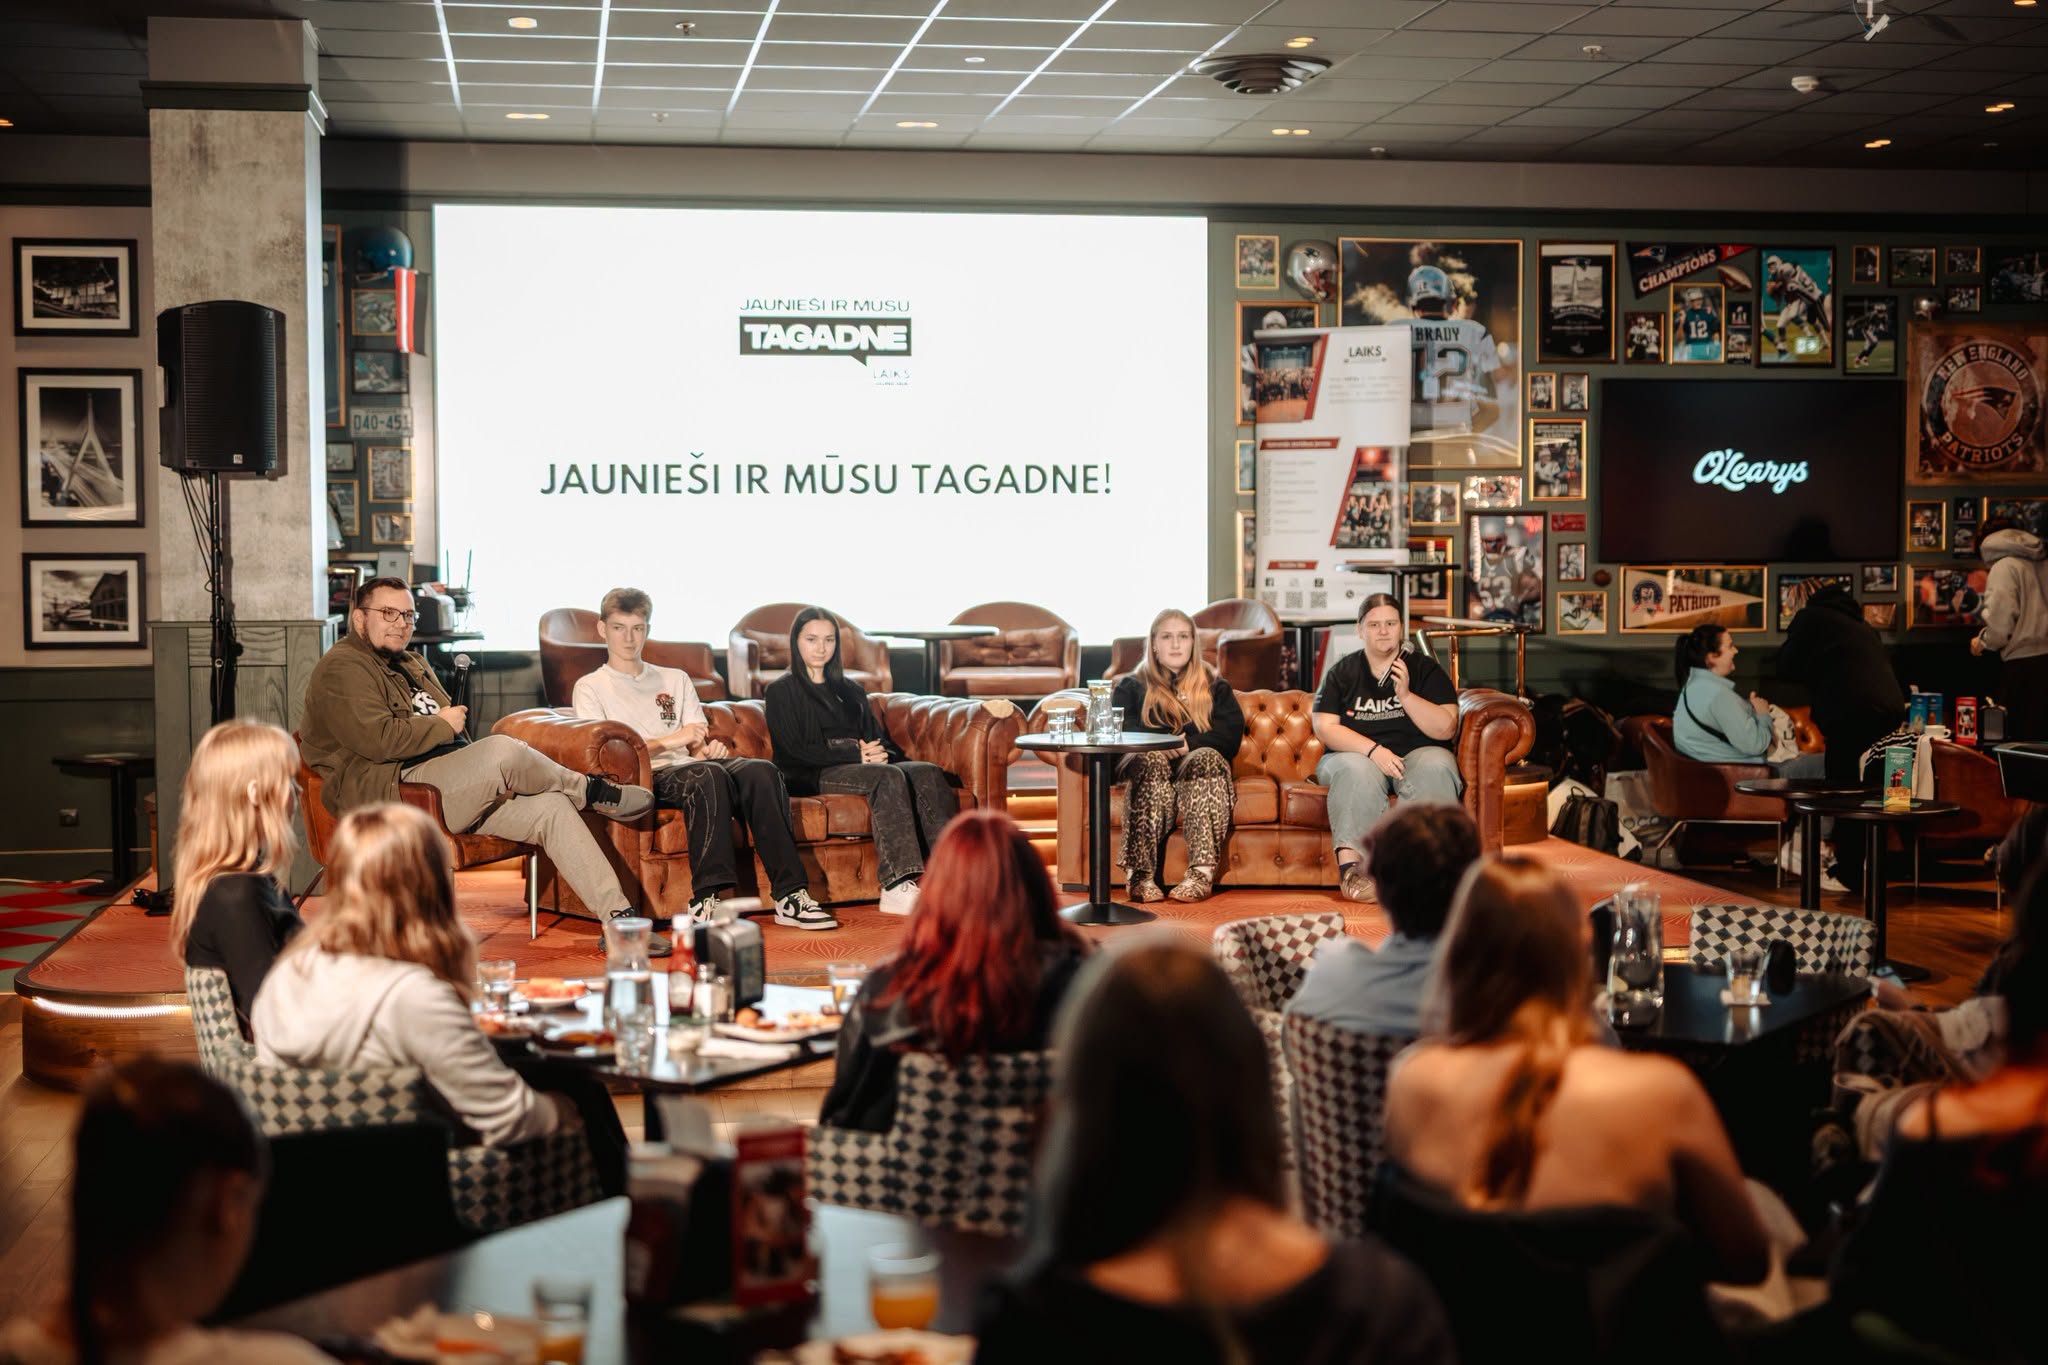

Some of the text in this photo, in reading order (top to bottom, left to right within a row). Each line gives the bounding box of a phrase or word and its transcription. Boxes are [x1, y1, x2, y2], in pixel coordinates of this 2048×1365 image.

[1639, 248, 1717, 292] CHAMPIONS
[831, 299, 848, 312] IR
[743, 323, 908, 351] TAGADNE
[1415, 327, 1460, 341] BRADY
[1689, 320, 1708, 339] 12
[1349, 346, 1382, 357] LAIKS
[1937, 344, 2029, 381] NEW ENGLAND
[1941, 431, 2024, 463] PATRIOTS
[541, 453, 1111, 494] JAUNIEŠI IR MŪSU TAGADNE!
[1669, 594, 1722, 614] PATRIOTS
[1355, 696, 1402, 713] LAIKS
